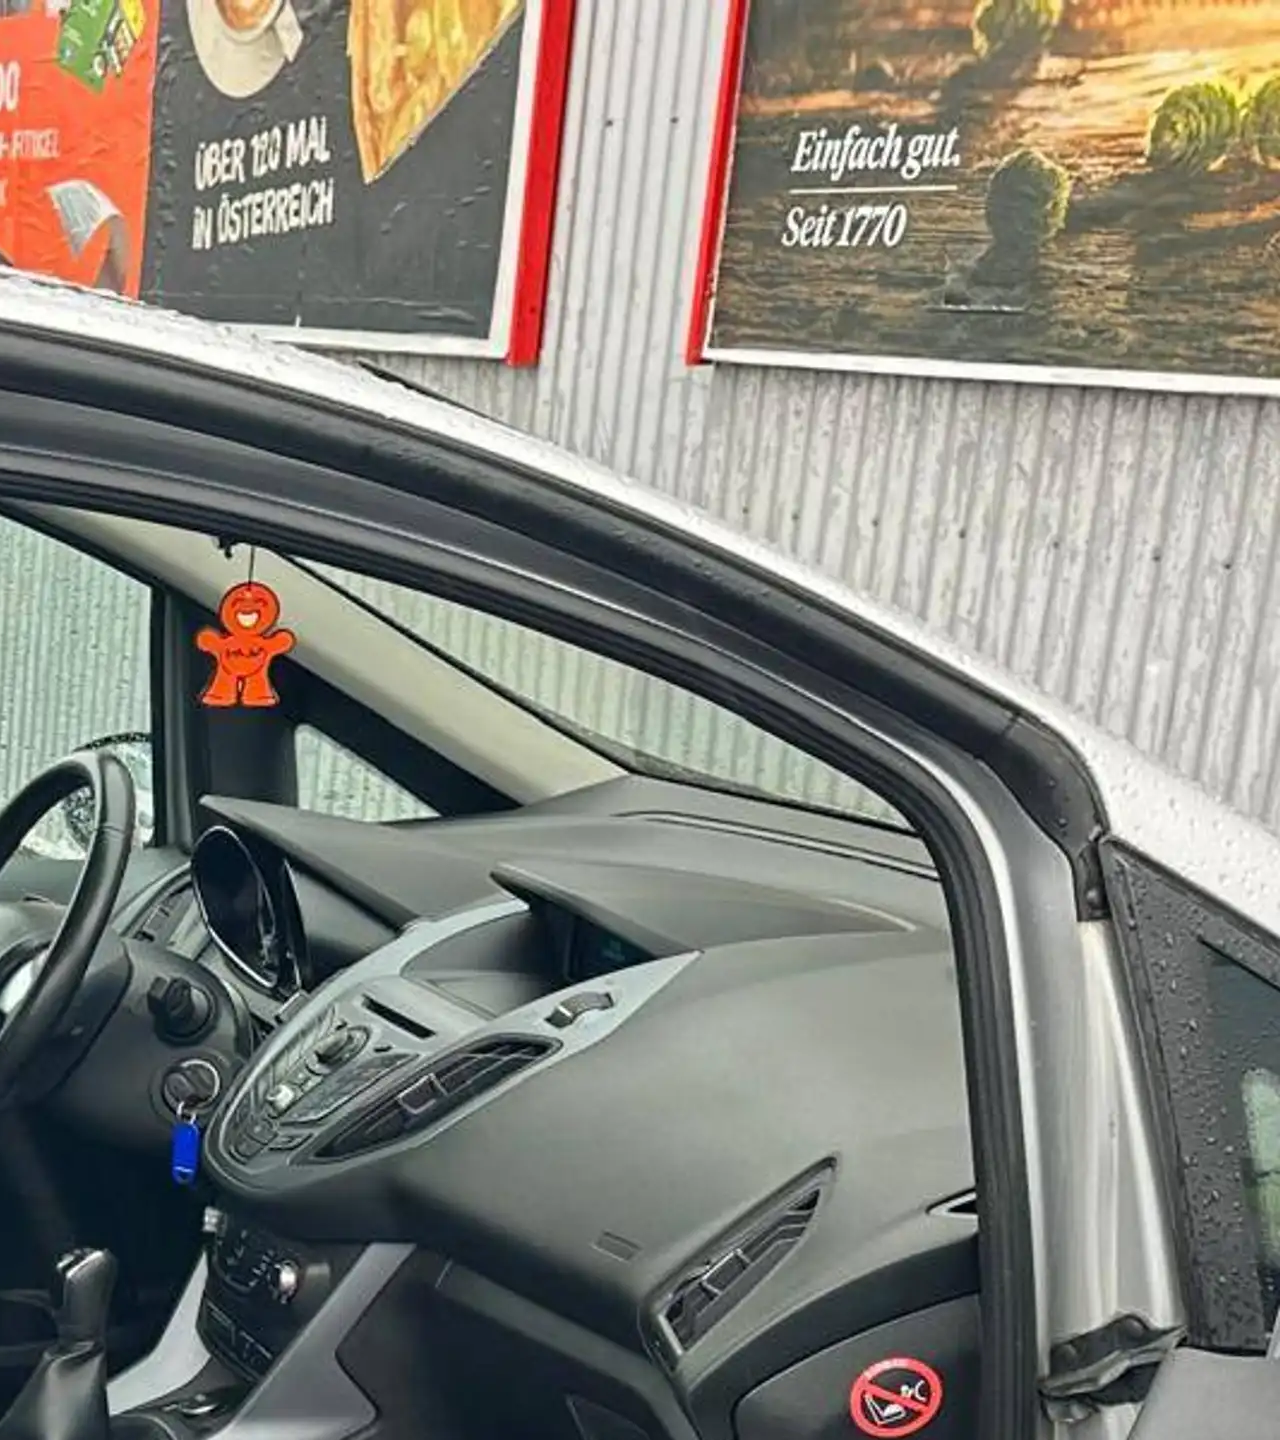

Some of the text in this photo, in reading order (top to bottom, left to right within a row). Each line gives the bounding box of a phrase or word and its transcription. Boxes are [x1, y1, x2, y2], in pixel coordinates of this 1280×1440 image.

[195, 115, 331, 191] ÜBER 120 MAL
[790, 122, 962, 182] Einfach gut.
[192, 177, 335, 250] IN ÖSTERREICH
[780, 203, 908, 248] Seit 1770
